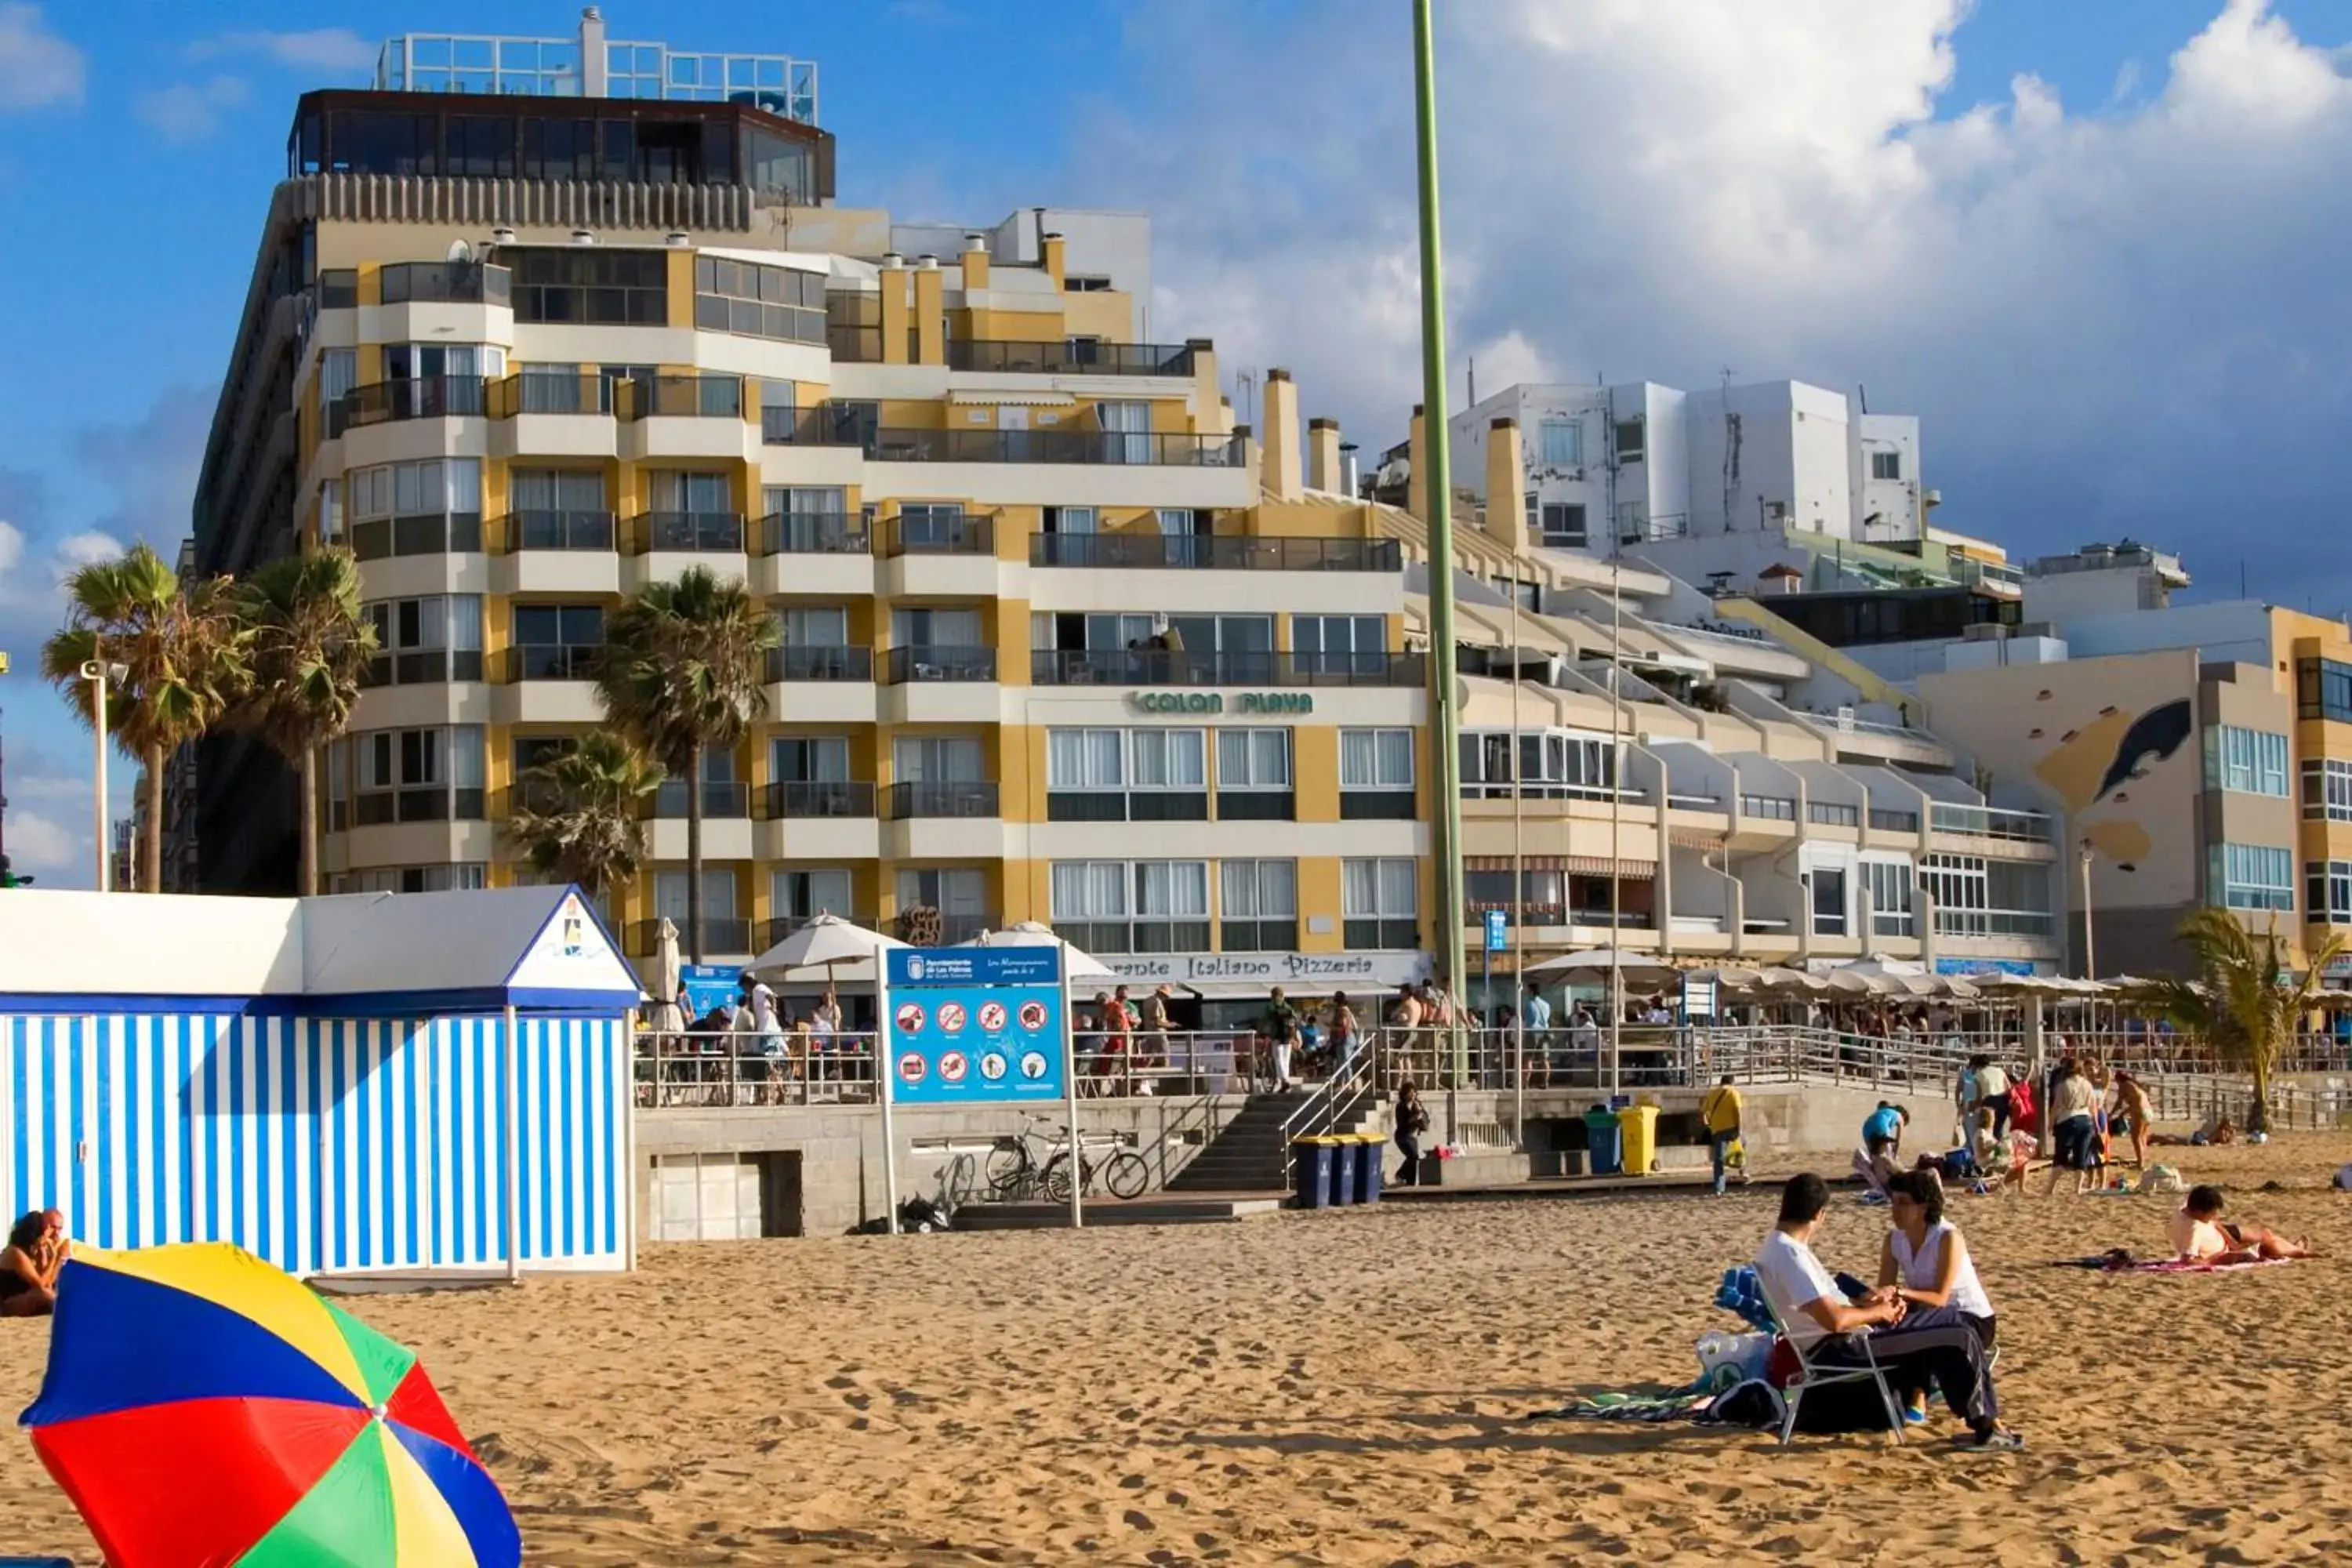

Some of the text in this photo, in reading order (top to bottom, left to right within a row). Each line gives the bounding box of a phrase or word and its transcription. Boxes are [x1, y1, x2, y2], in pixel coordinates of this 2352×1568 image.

[1142, 692, 1313, 713] COLON PLAYA
[1106, 954, 1373, 978] rante Italiano Pizzeria
